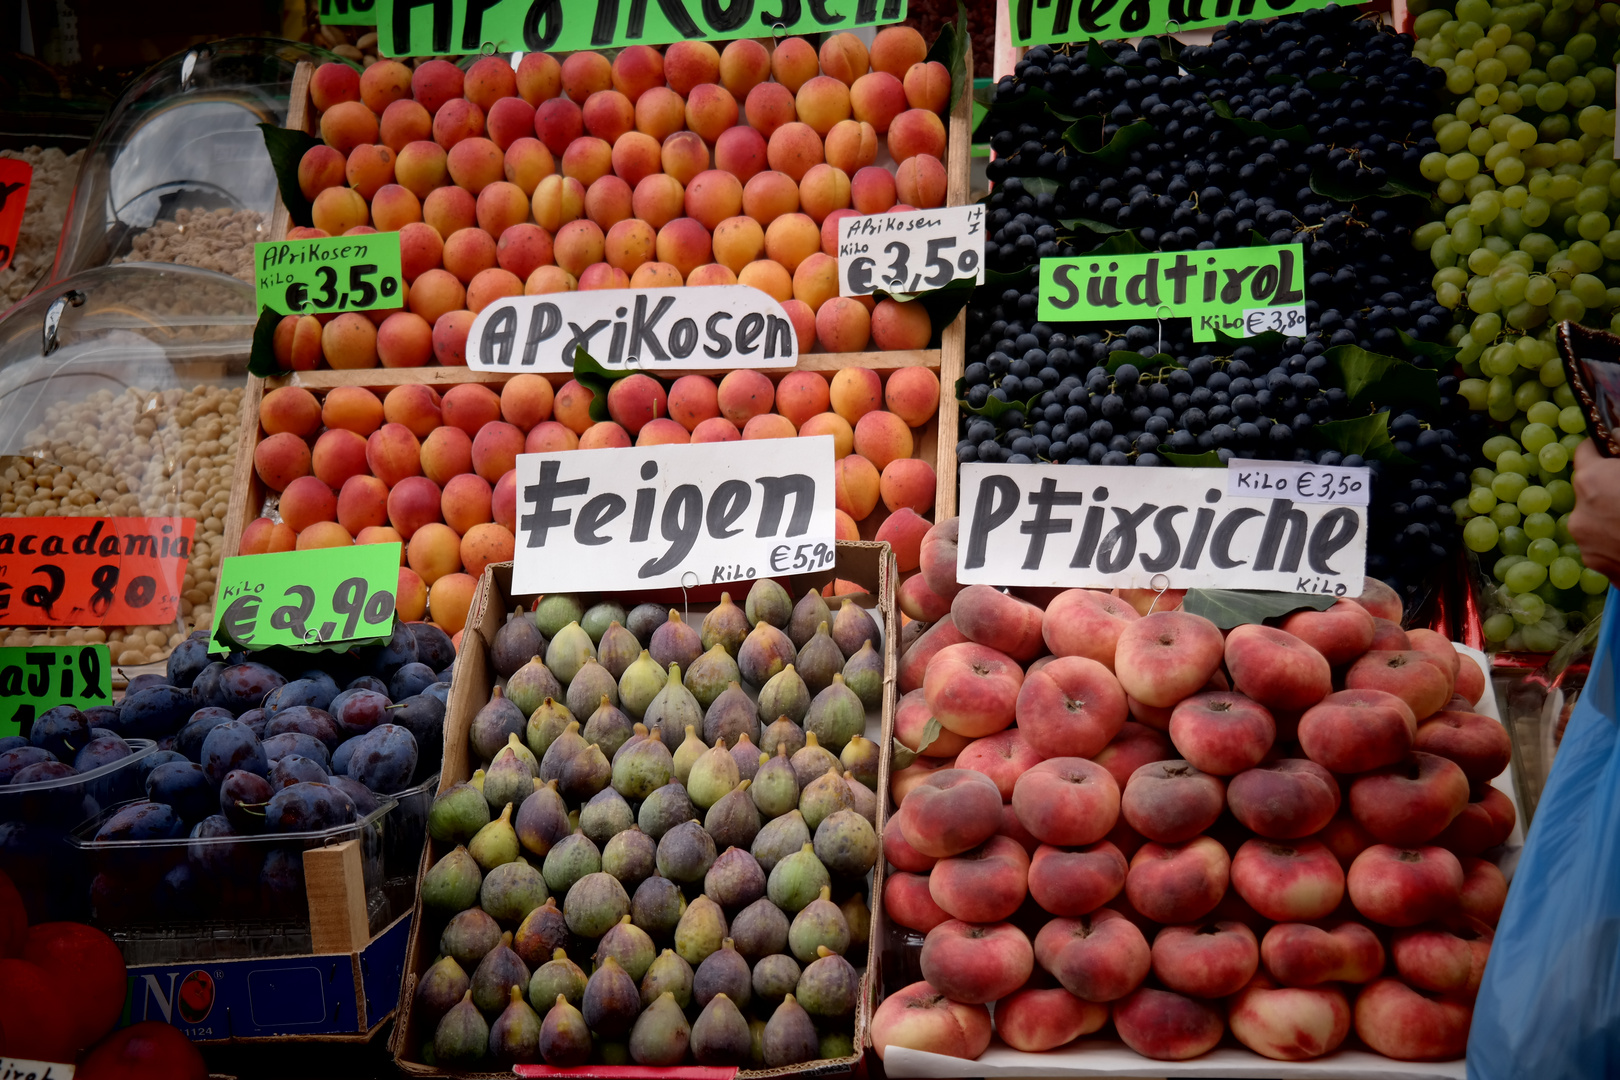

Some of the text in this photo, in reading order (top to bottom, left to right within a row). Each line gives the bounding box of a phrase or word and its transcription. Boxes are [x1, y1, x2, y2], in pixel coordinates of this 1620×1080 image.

[285, 264, 397, 311] €3,50
[847, 236, 979, 294] €3,50
[1246, 310, 1305, 335] €3,80
[1296, 471, 1362, 500] €3,50
[520, 460, 816, 579] Feigen
[769, 542, 834, 573] €5,90
[222, 576, 396, 645] €2,90
